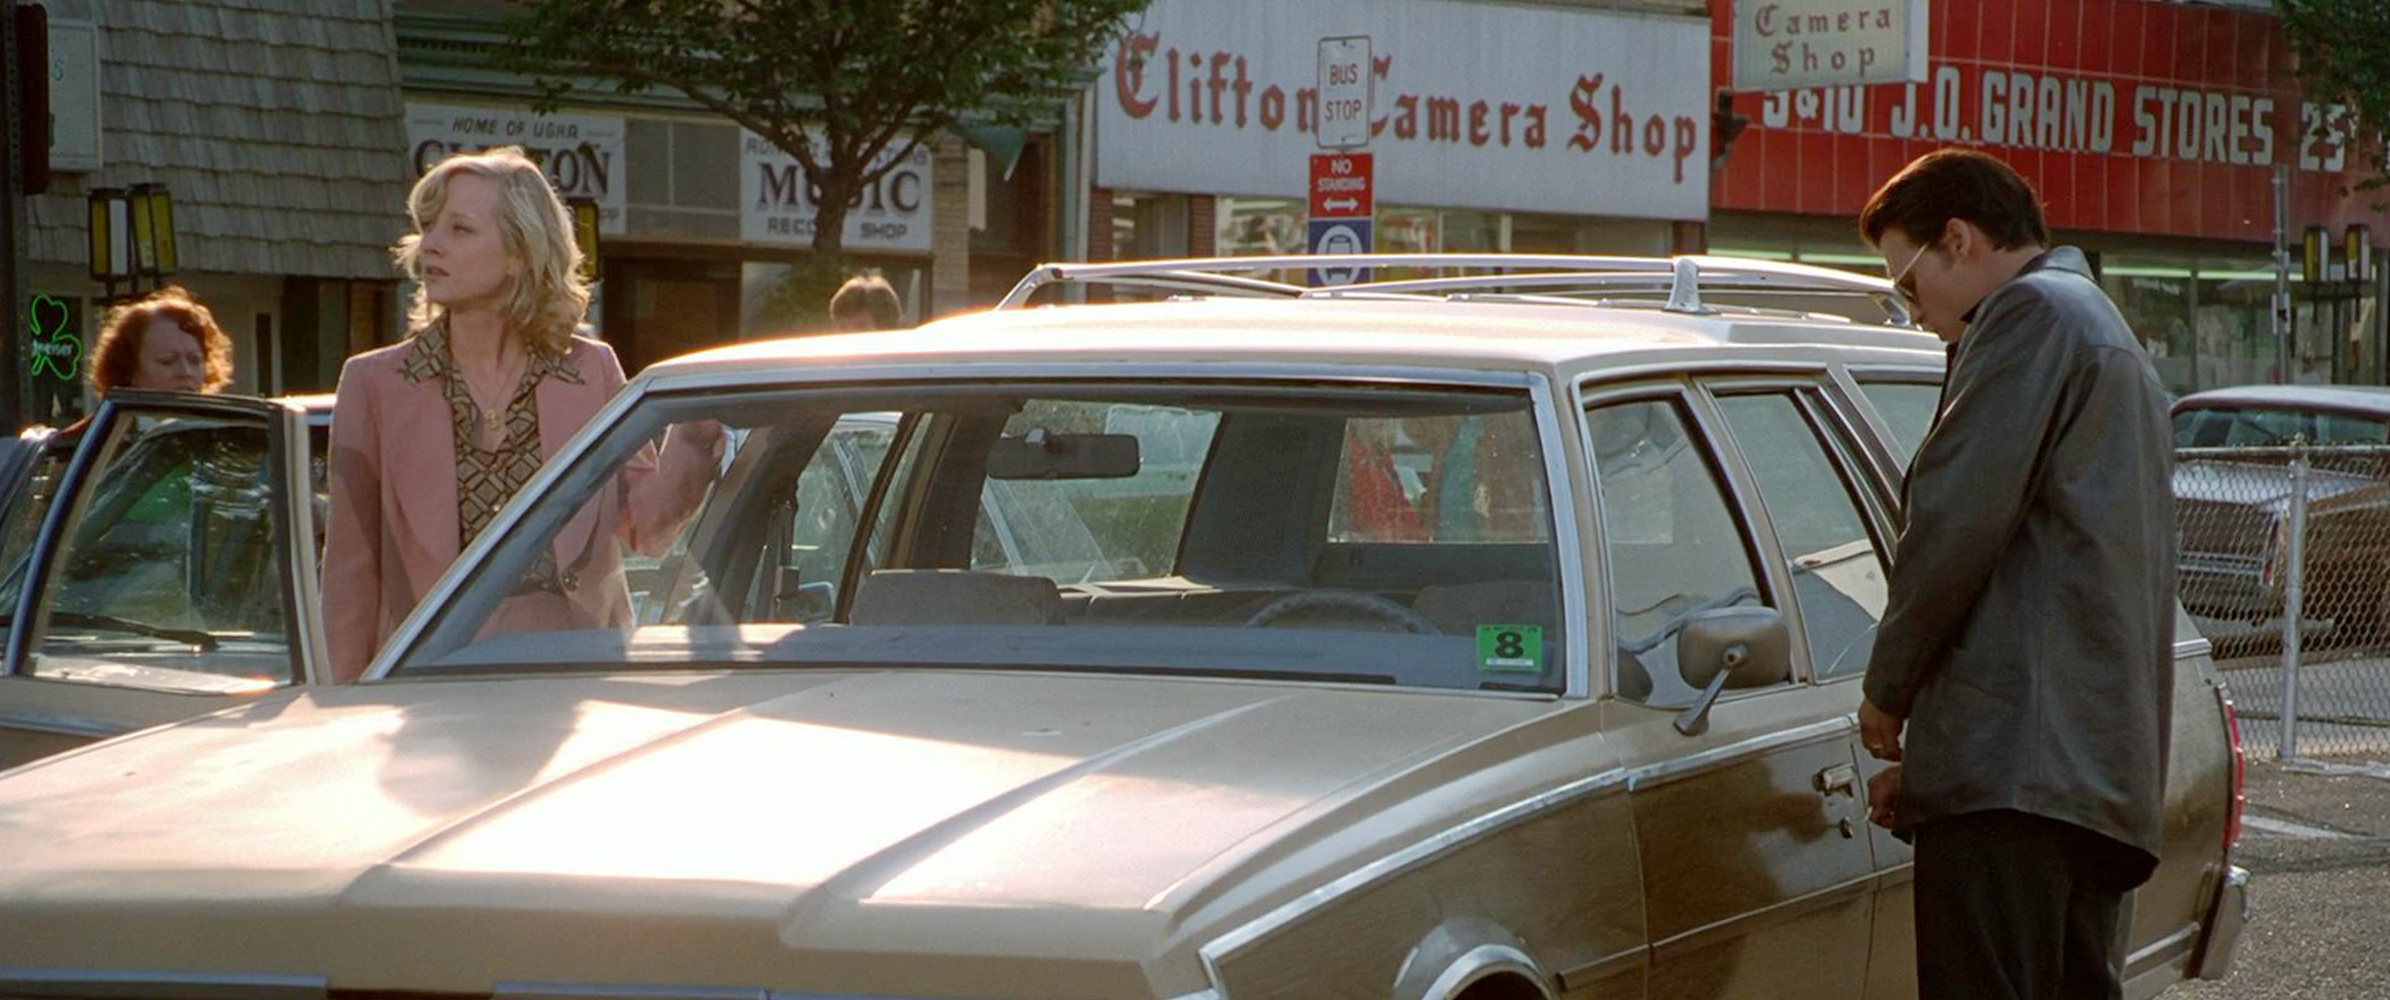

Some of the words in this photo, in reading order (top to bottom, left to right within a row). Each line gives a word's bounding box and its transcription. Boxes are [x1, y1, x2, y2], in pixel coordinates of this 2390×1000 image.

[1755, 4, 1891, 37] Camera
[1771, 40, 1875, 78] Shop
[1330, 63, 1358, 85] BUS
[1116, 31, 1317, 134] Clifton
[1566, 73, 1697, 184] Shop
[1325, 99, 1362, 122] STOP
[1981, 69, 2115, 152] GRAND
[2132, 86, 2274, 165] STORES
[453, 117, 497, 134] HOME
[506, 120, 524, 135] OF
[415, 139, 613, 195] CTON
[1331, 159, 1353, 175] NO
[758, 163, 921, 212] MIC
[1317, 177, 1366, 192] STANDING
[767, 216, 817, 236] RECO
[860, 222, 908, 240] SHOP
[1495, 631, 1524, 659] 8
